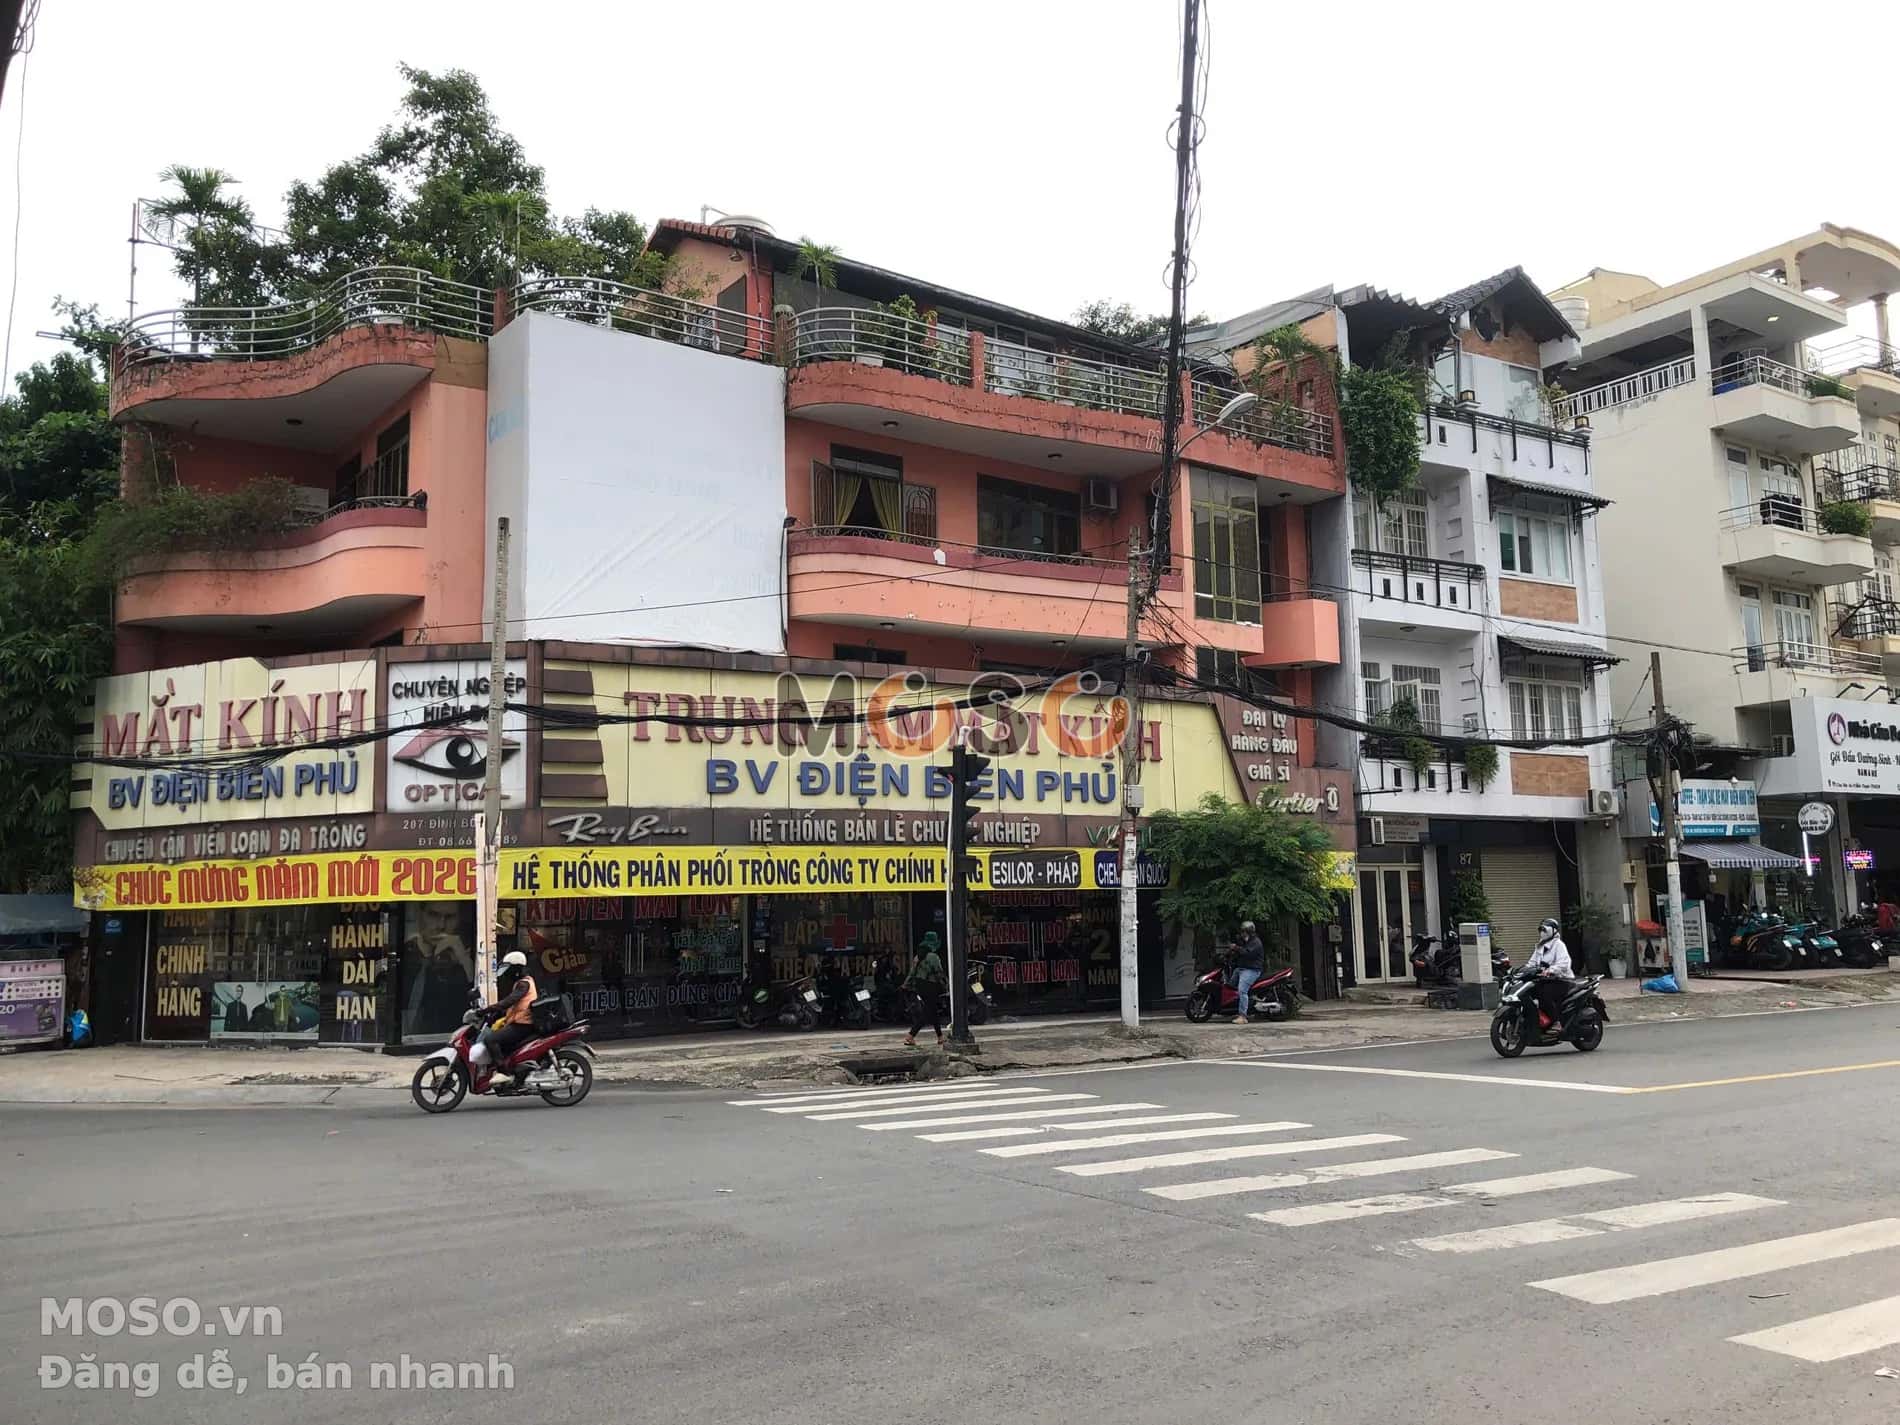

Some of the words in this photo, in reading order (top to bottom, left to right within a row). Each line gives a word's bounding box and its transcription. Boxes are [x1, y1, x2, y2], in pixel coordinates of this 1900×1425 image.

[392, 675, 459, 698] CHUYÊN
[466, 671, 527, 698] NGỆP
[218, 679, 367, 750] KÍNH
[623, 691, 809, 746] TRUNG
[108, 776, 144, 809] BV
[294, 751, 359, 797] PHỦ
[706, 759, 779, 794] BV
[796, 753, 910, 806] ĐIỆN
[1035, 762, 1117, 804] PHỦ
[1247, 759, 1272, 781] GIÁ
[230, 828, 272, 860] LOẠN
[278, 827, 302, 851] ĐA
[778, 808, 838, 842] THỐNG
[843, 811, 878, 842] BÁN
[883, 812, 906, 842] LẺ
[982, 815, 1041, 849] NGHIỆP
[115, 865, 172, 905] CHÚC
[391, 857, 478, 896] 2026
[512, 854, 541, 896] HỆ
[549, 849, 620, 889] THỐNG
[626, 852, 681, 888] PHÂN
[687, 848, 733, 887] PHỐI
[738, 852, 801, 886] TRÒNG
[805, 851, 854, 886] CÔNG
[857, 858, 880, 884] TY
[884, 852, 936, 884] CHÍNH
[992, 861, 1035, 885] ESILOR
[1046, 856, 1080, 885] PHÁP
[331, 919, 385, 949] HÀNH
[156, 937, 206, 974] CHÍNH
[342, 953, 376, 985] DÀI
[335, 996, 377, 1025] HẠN
